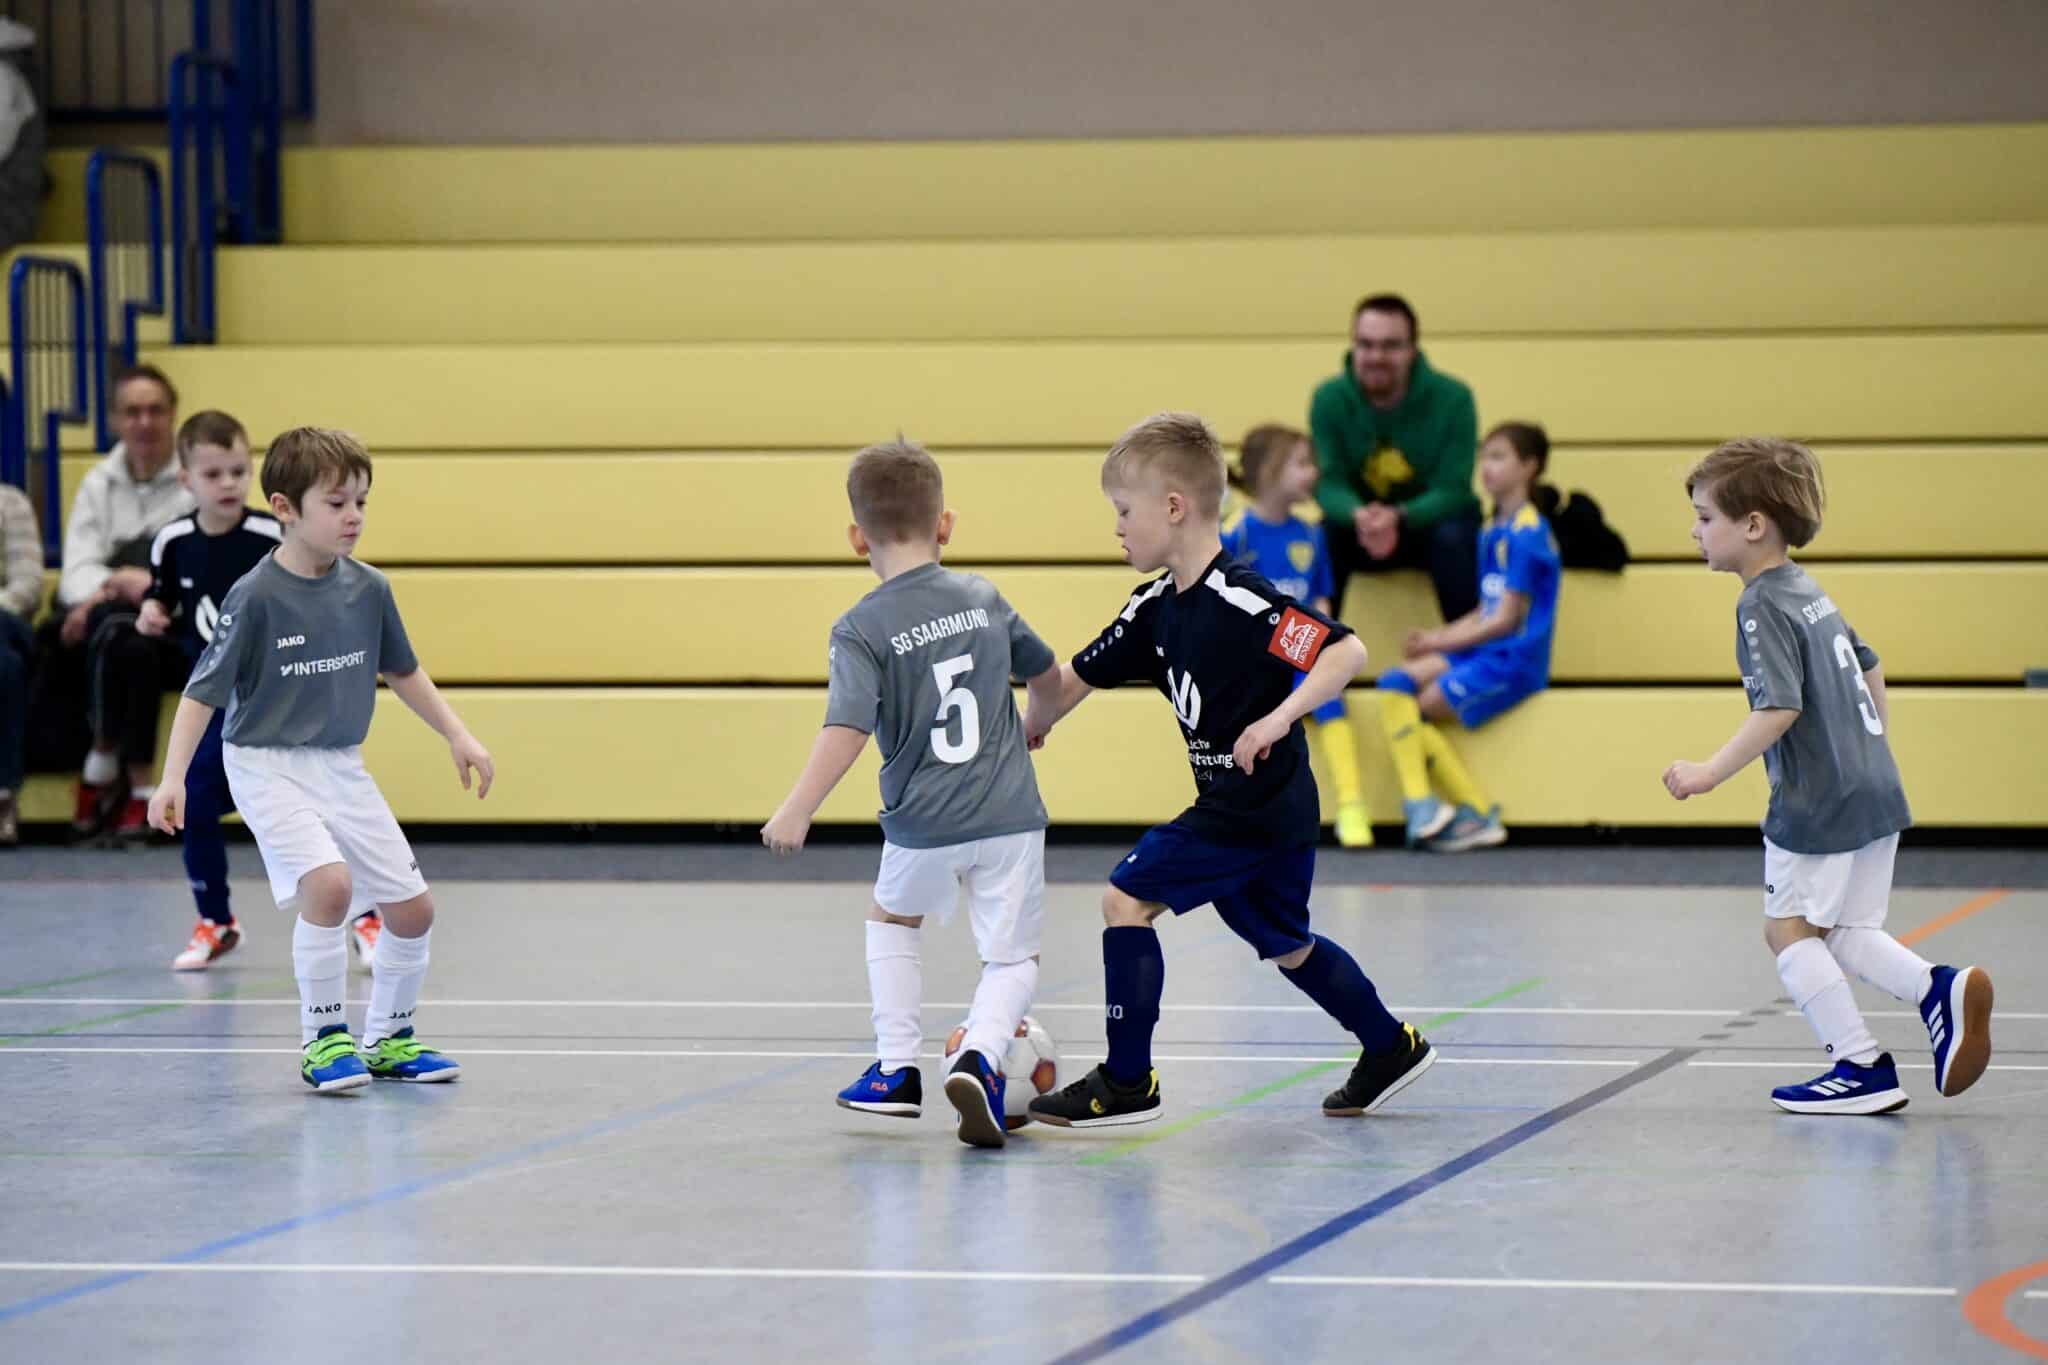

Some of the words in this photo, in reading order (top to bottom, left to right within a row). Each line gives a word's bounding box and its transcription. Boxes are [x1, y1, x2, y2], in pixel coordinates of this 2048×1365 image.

[277, 635, 305, 649] JAKO
[891, 632, 913, 655] SG
[912, 608, 989, 647] SAARMUND
[294, 650, 367, 676] INTERSPORT
[1833, 633, 1883, 736] 3
[930, 654, 980, 764] 5
